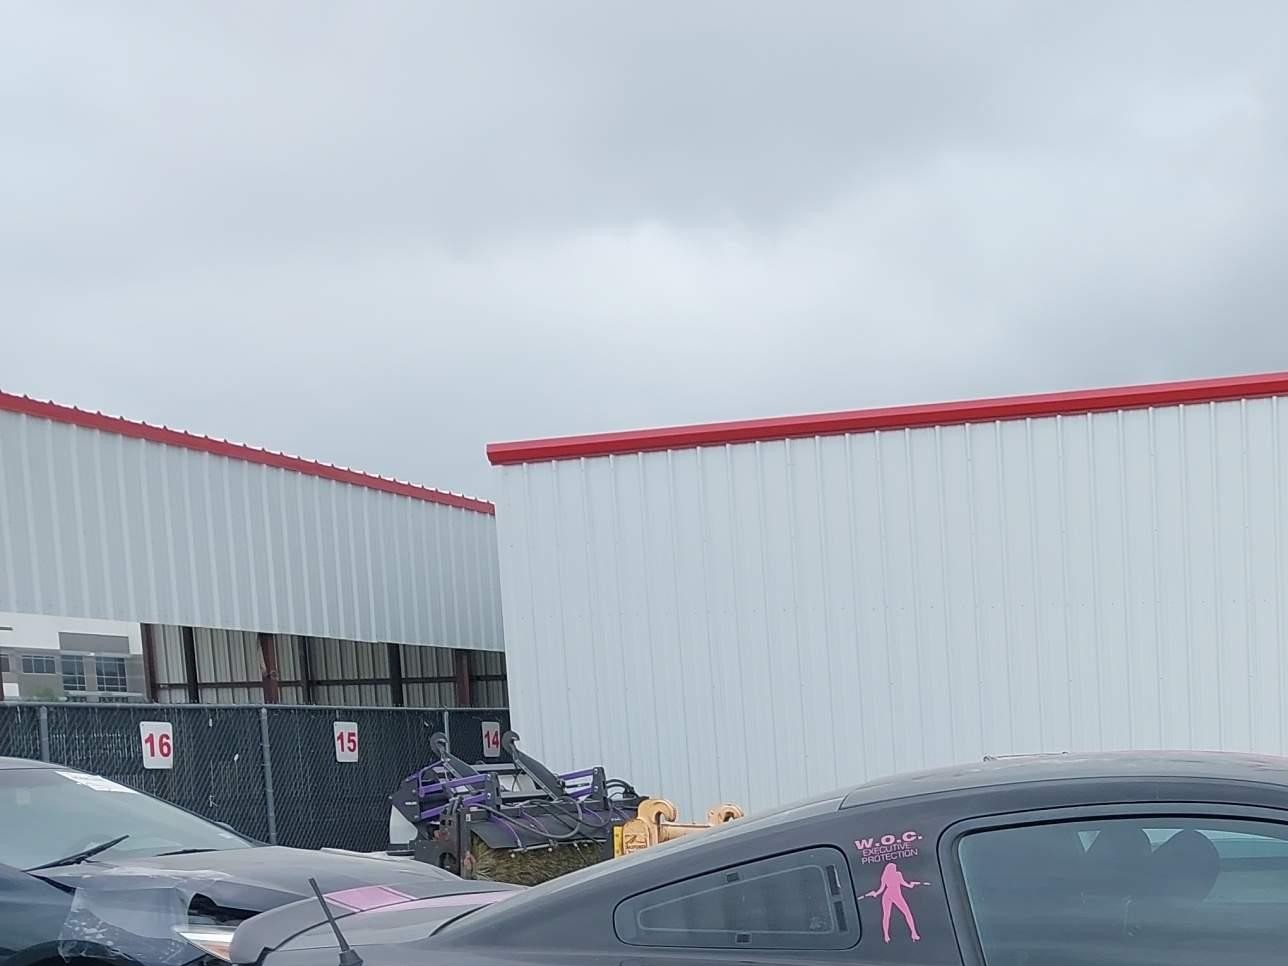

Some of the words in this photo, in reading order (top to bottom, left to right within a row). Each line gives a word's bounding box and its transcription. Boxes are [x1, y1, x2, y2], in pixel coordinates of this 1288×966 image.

[144, 733, 172, 757] 16
[336, 731, 358, 753] 15
[484, 729, 500, 750] 14
[854, 831, 922, 850] W.O.C.
[862, 843, 912, 857] EXECUTIVE
[861, 849, 918, 864] PROTECTION
